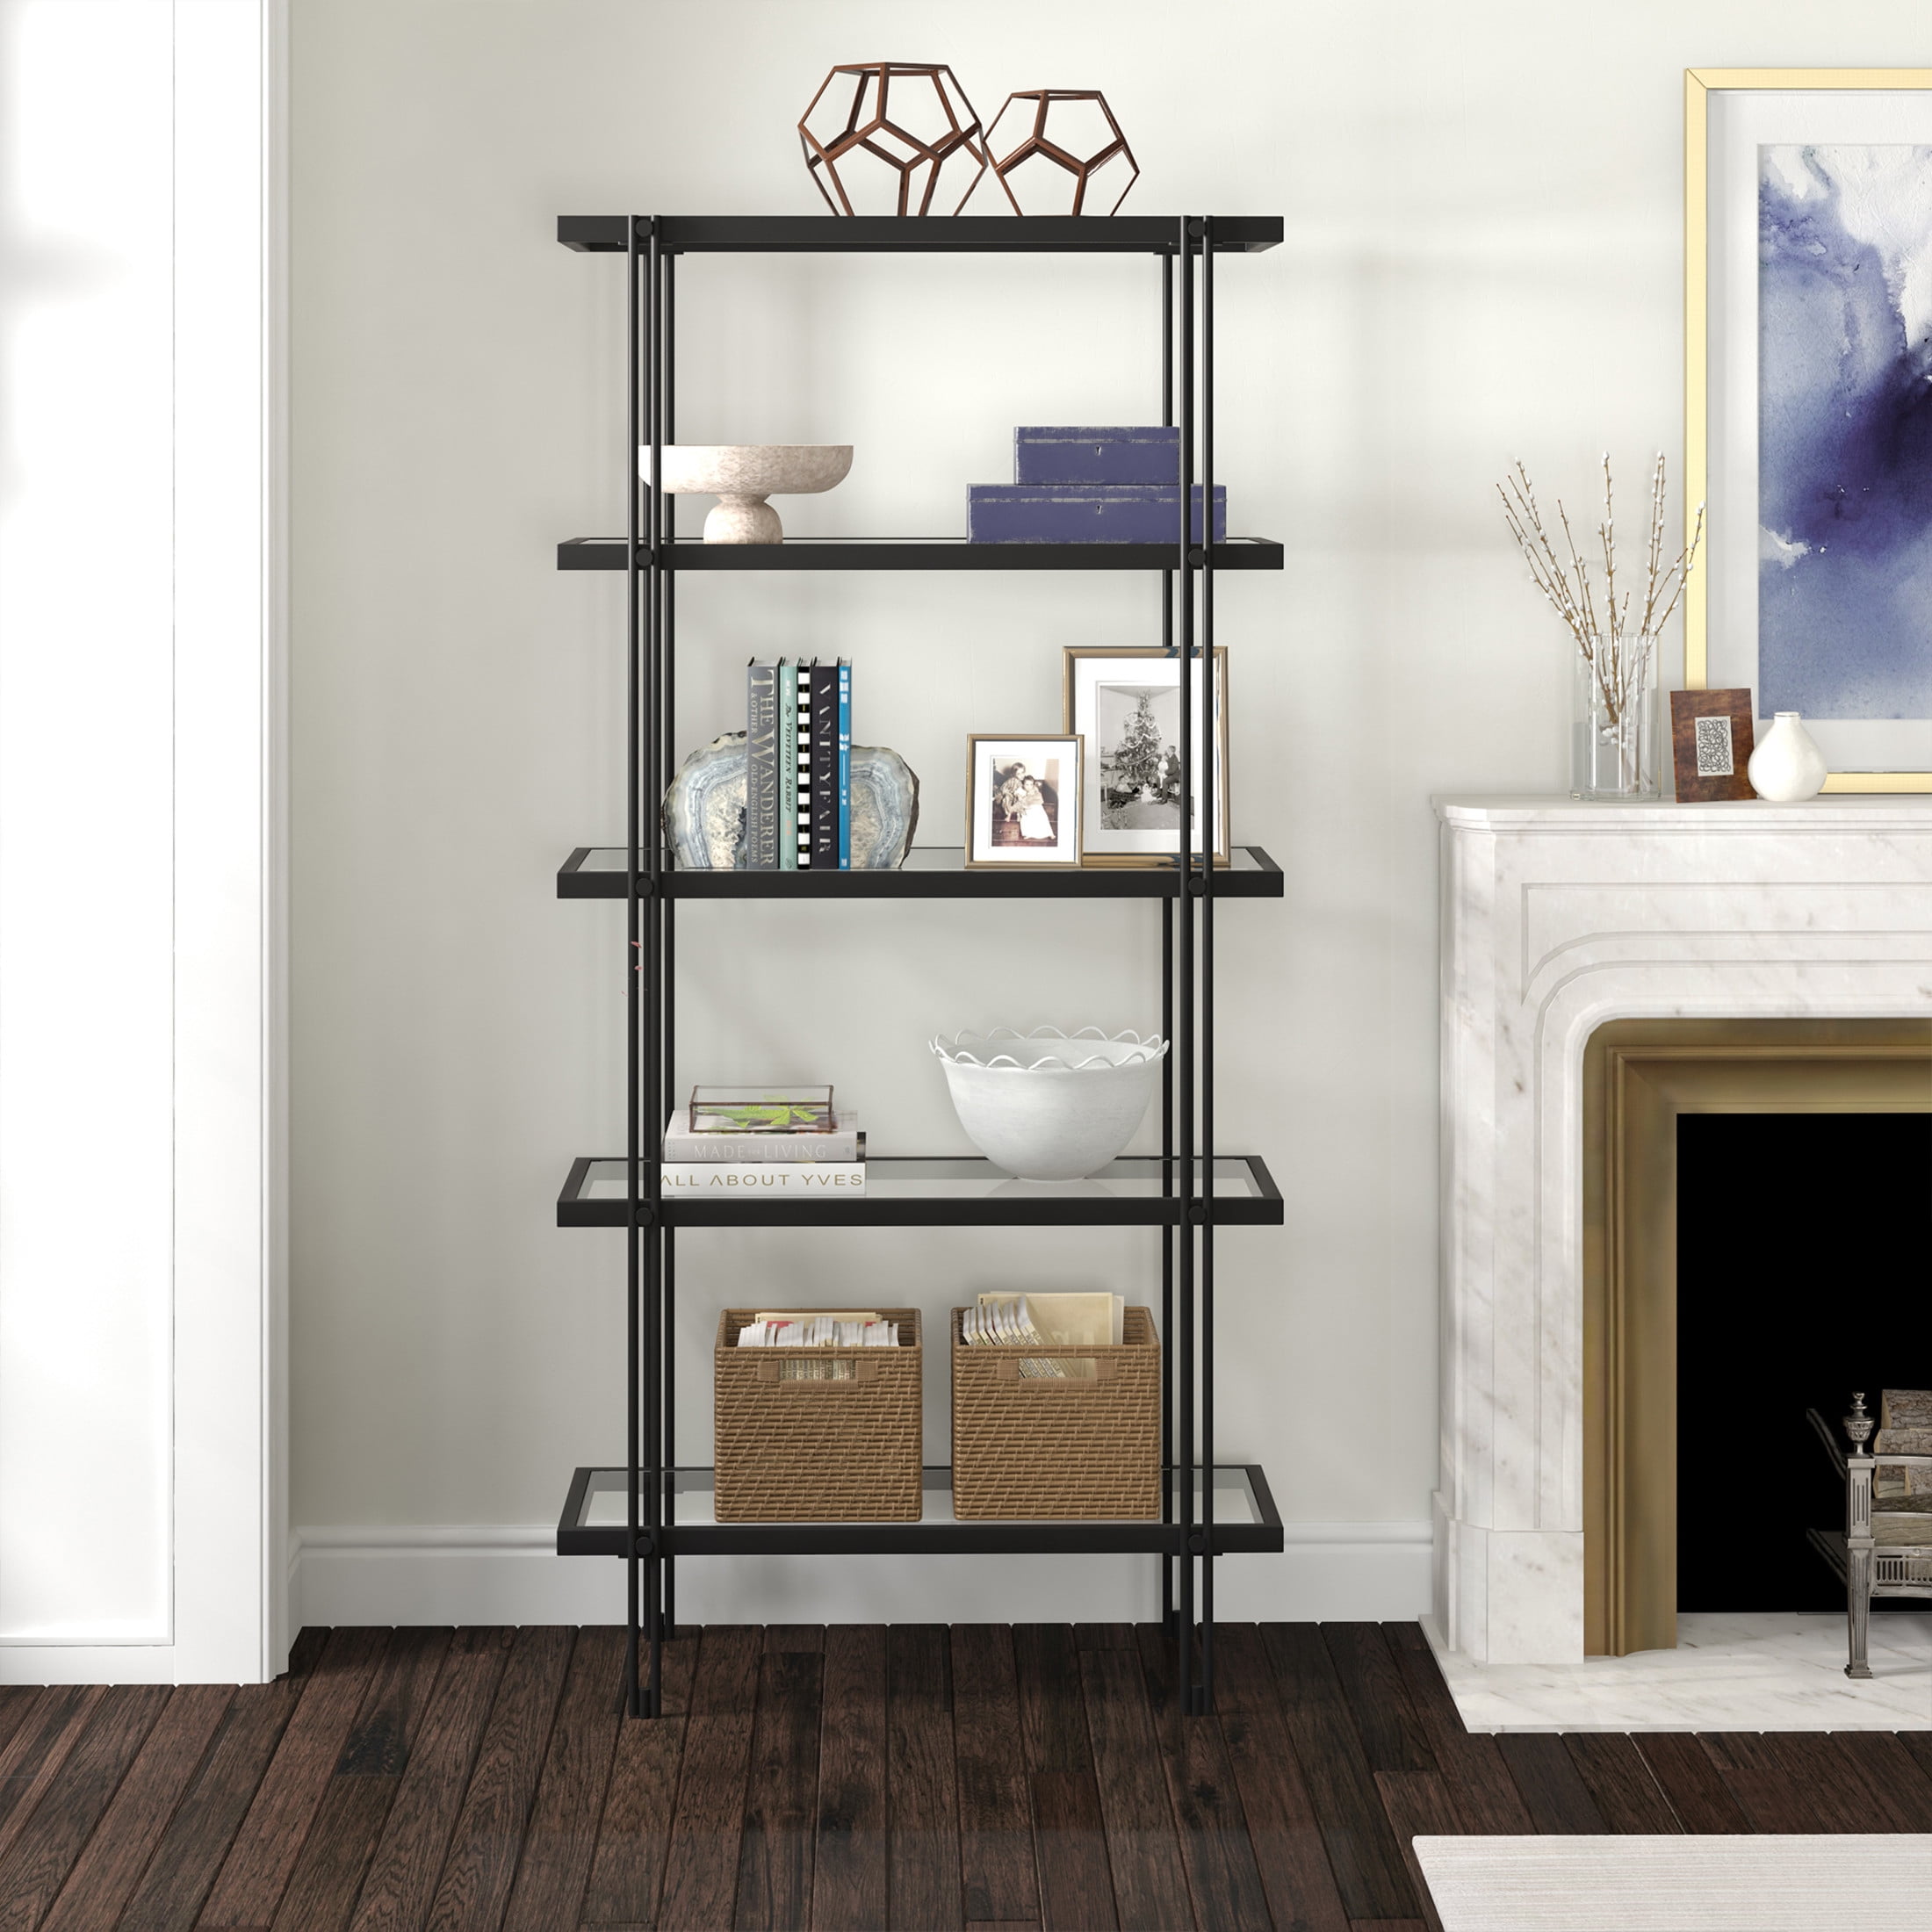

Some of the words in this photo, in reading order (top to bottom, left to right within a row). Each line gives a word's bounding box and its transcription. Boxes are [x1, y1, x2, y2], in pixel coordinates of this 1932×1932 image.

[751, 669, 775, 725] THE
[751, 729, 775, 866] WANDERER
[695, 1144, 746, 1158] MADE
[764, 1144, 827, 1159] LIVING
[660, 1174, 700, 1186] ALL
[710, 1174, 790, 1186] ABOUT
[801, 1174, 863, 1186] YVES
